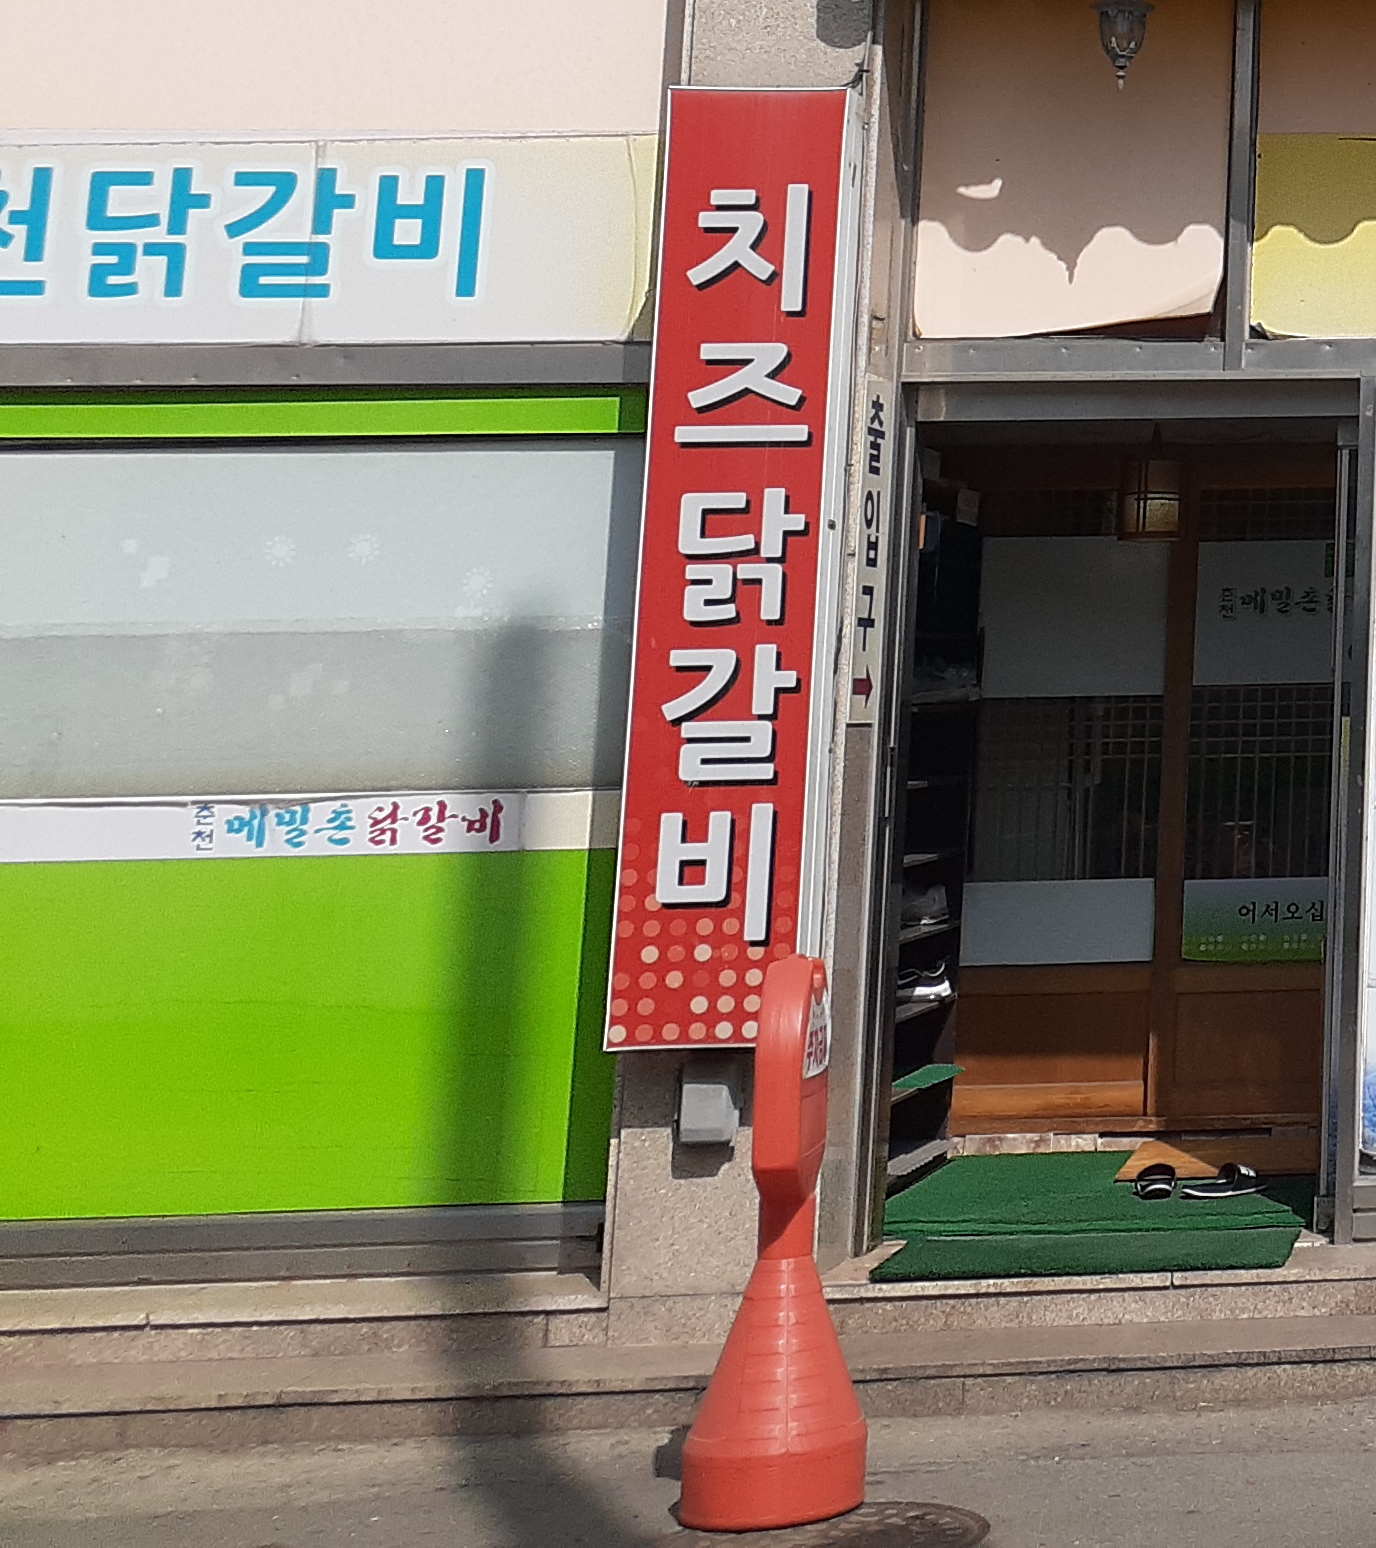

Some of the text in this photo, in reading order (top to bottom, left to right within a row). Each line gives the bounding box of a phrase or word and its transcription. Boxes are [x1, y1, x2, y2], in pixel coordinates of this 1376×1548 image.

[655, 183, 811, 943] 치즈닭갈비
[855, 392, 886, 651] 출입구
[225, 803, 356, 849] 메밀촌
[367, 799, 505, 846] 닭갈비
